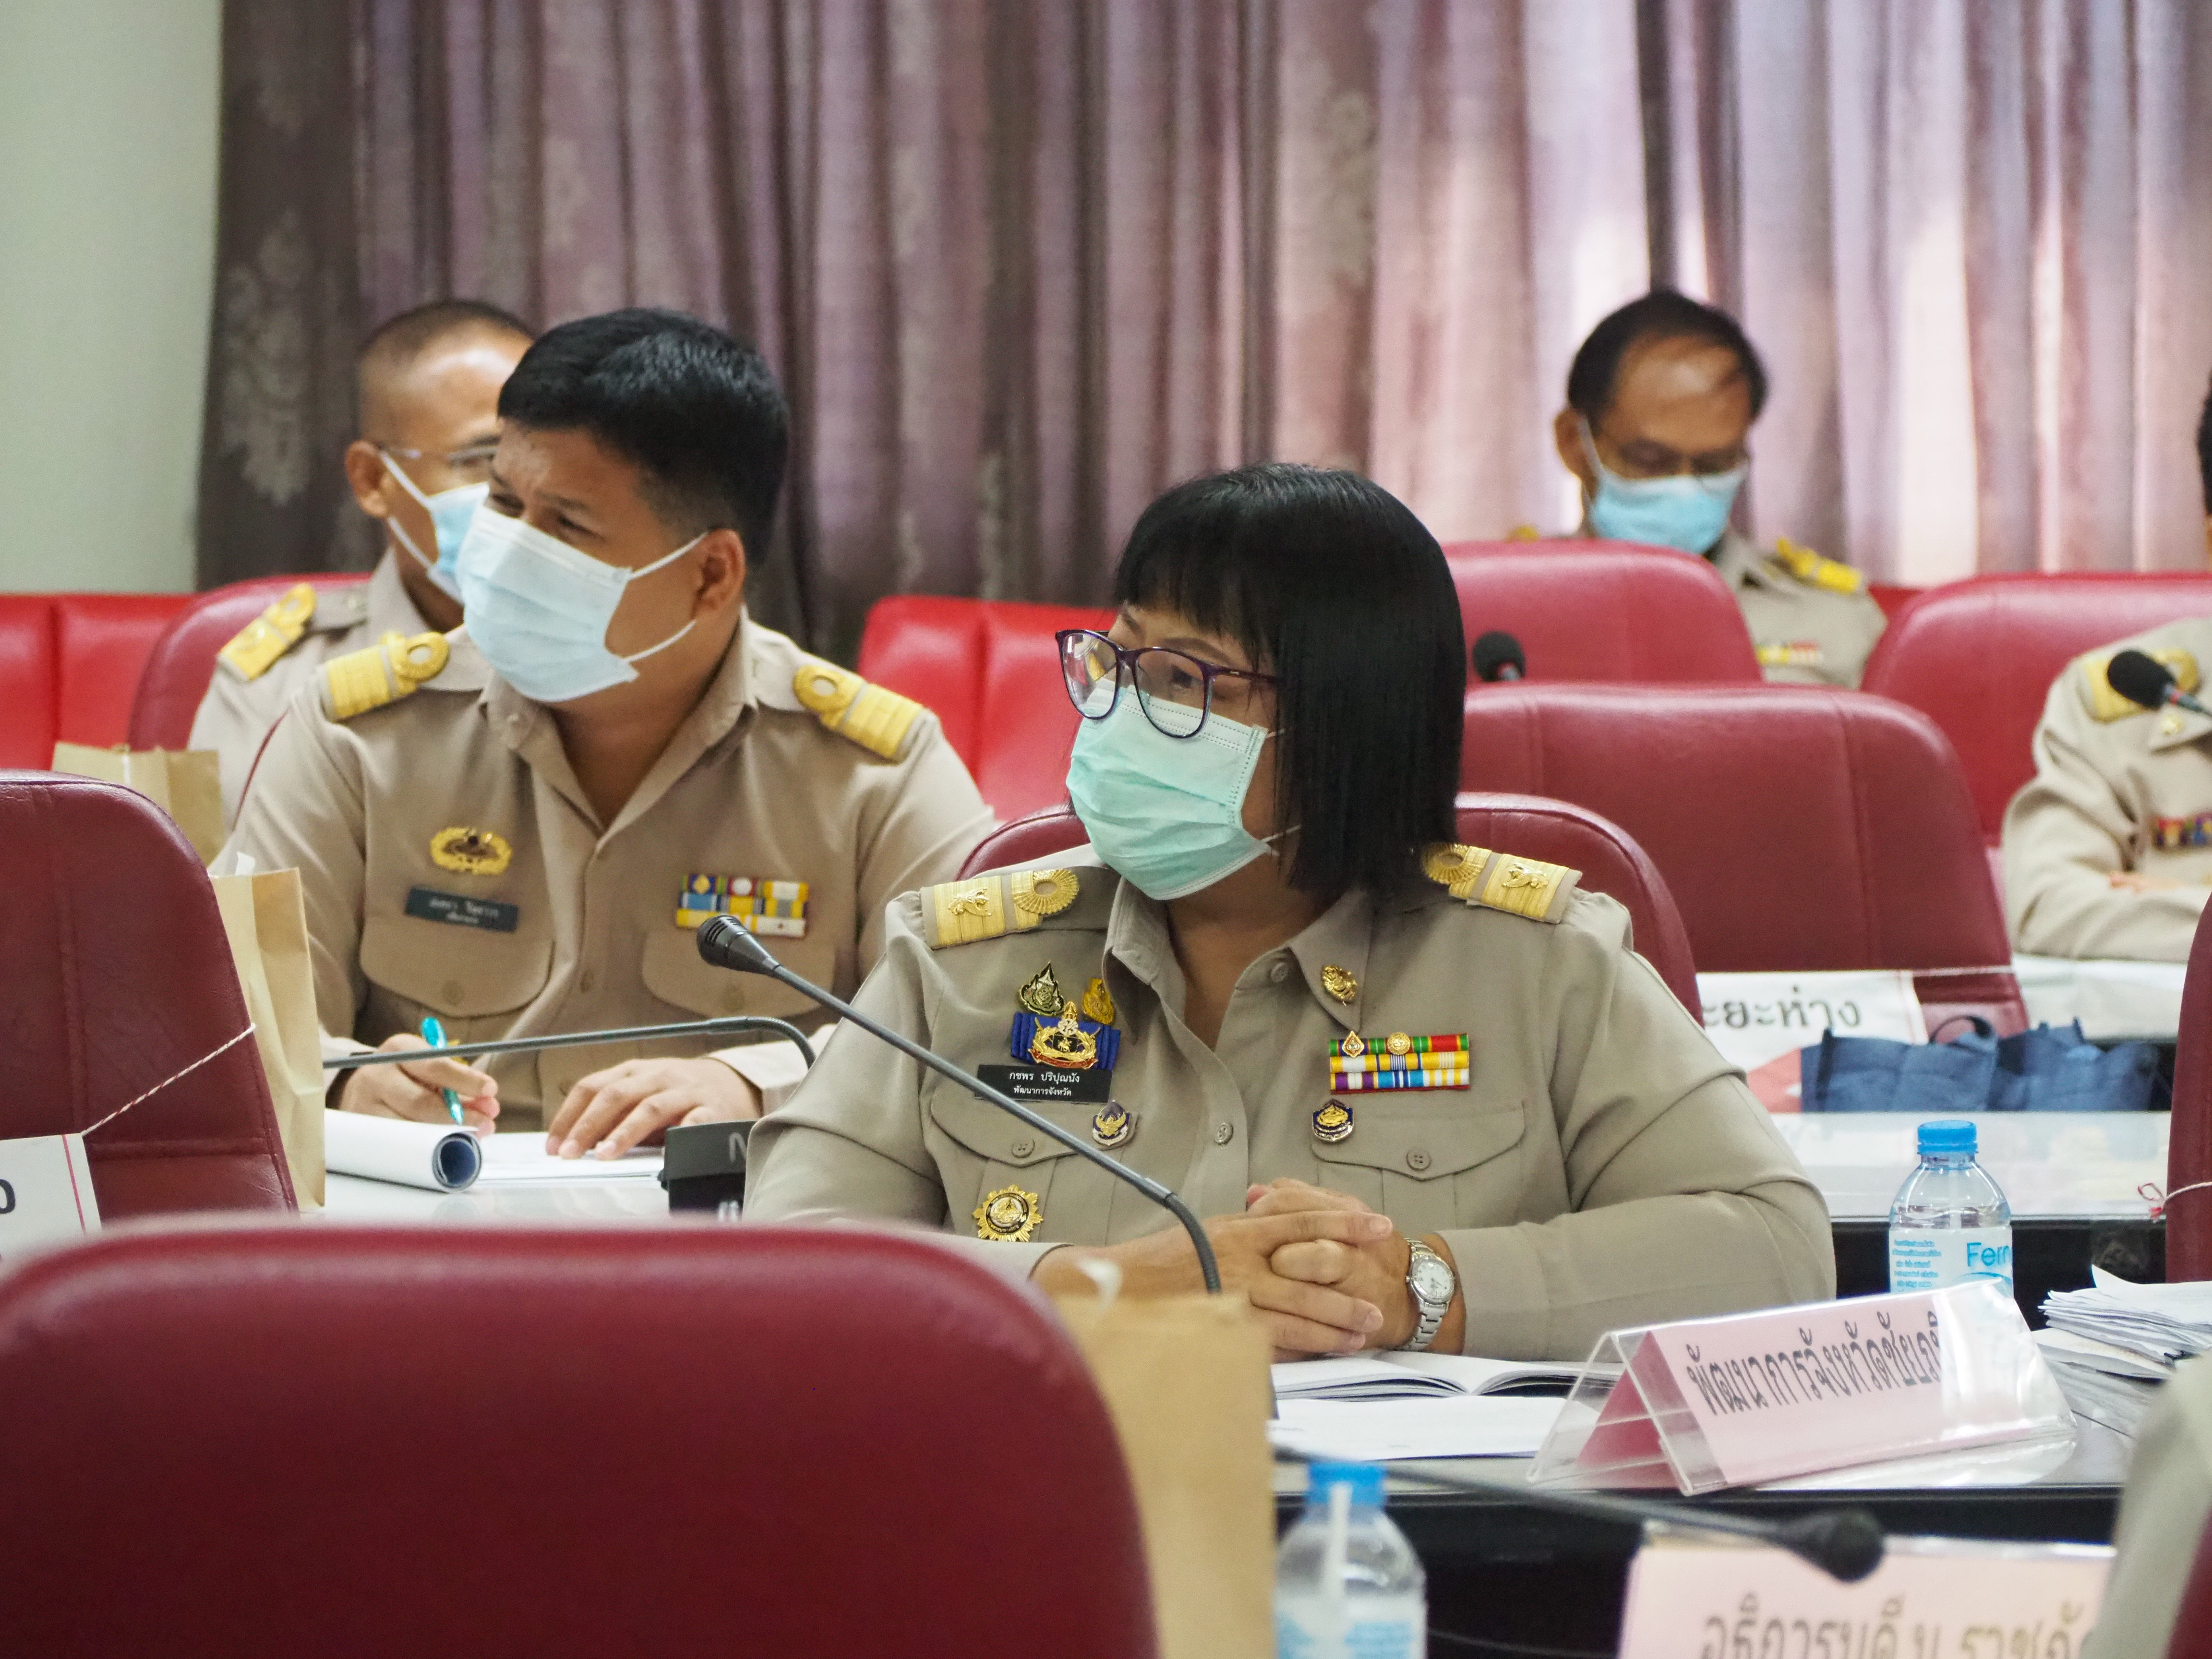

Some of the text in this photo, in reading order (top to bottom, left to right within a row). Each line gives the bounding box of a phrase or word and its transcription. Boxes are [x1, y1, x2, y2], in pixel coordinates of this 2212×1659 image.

[1013, 1085, 1072, 1096] พัฒนาการจังหวัด
